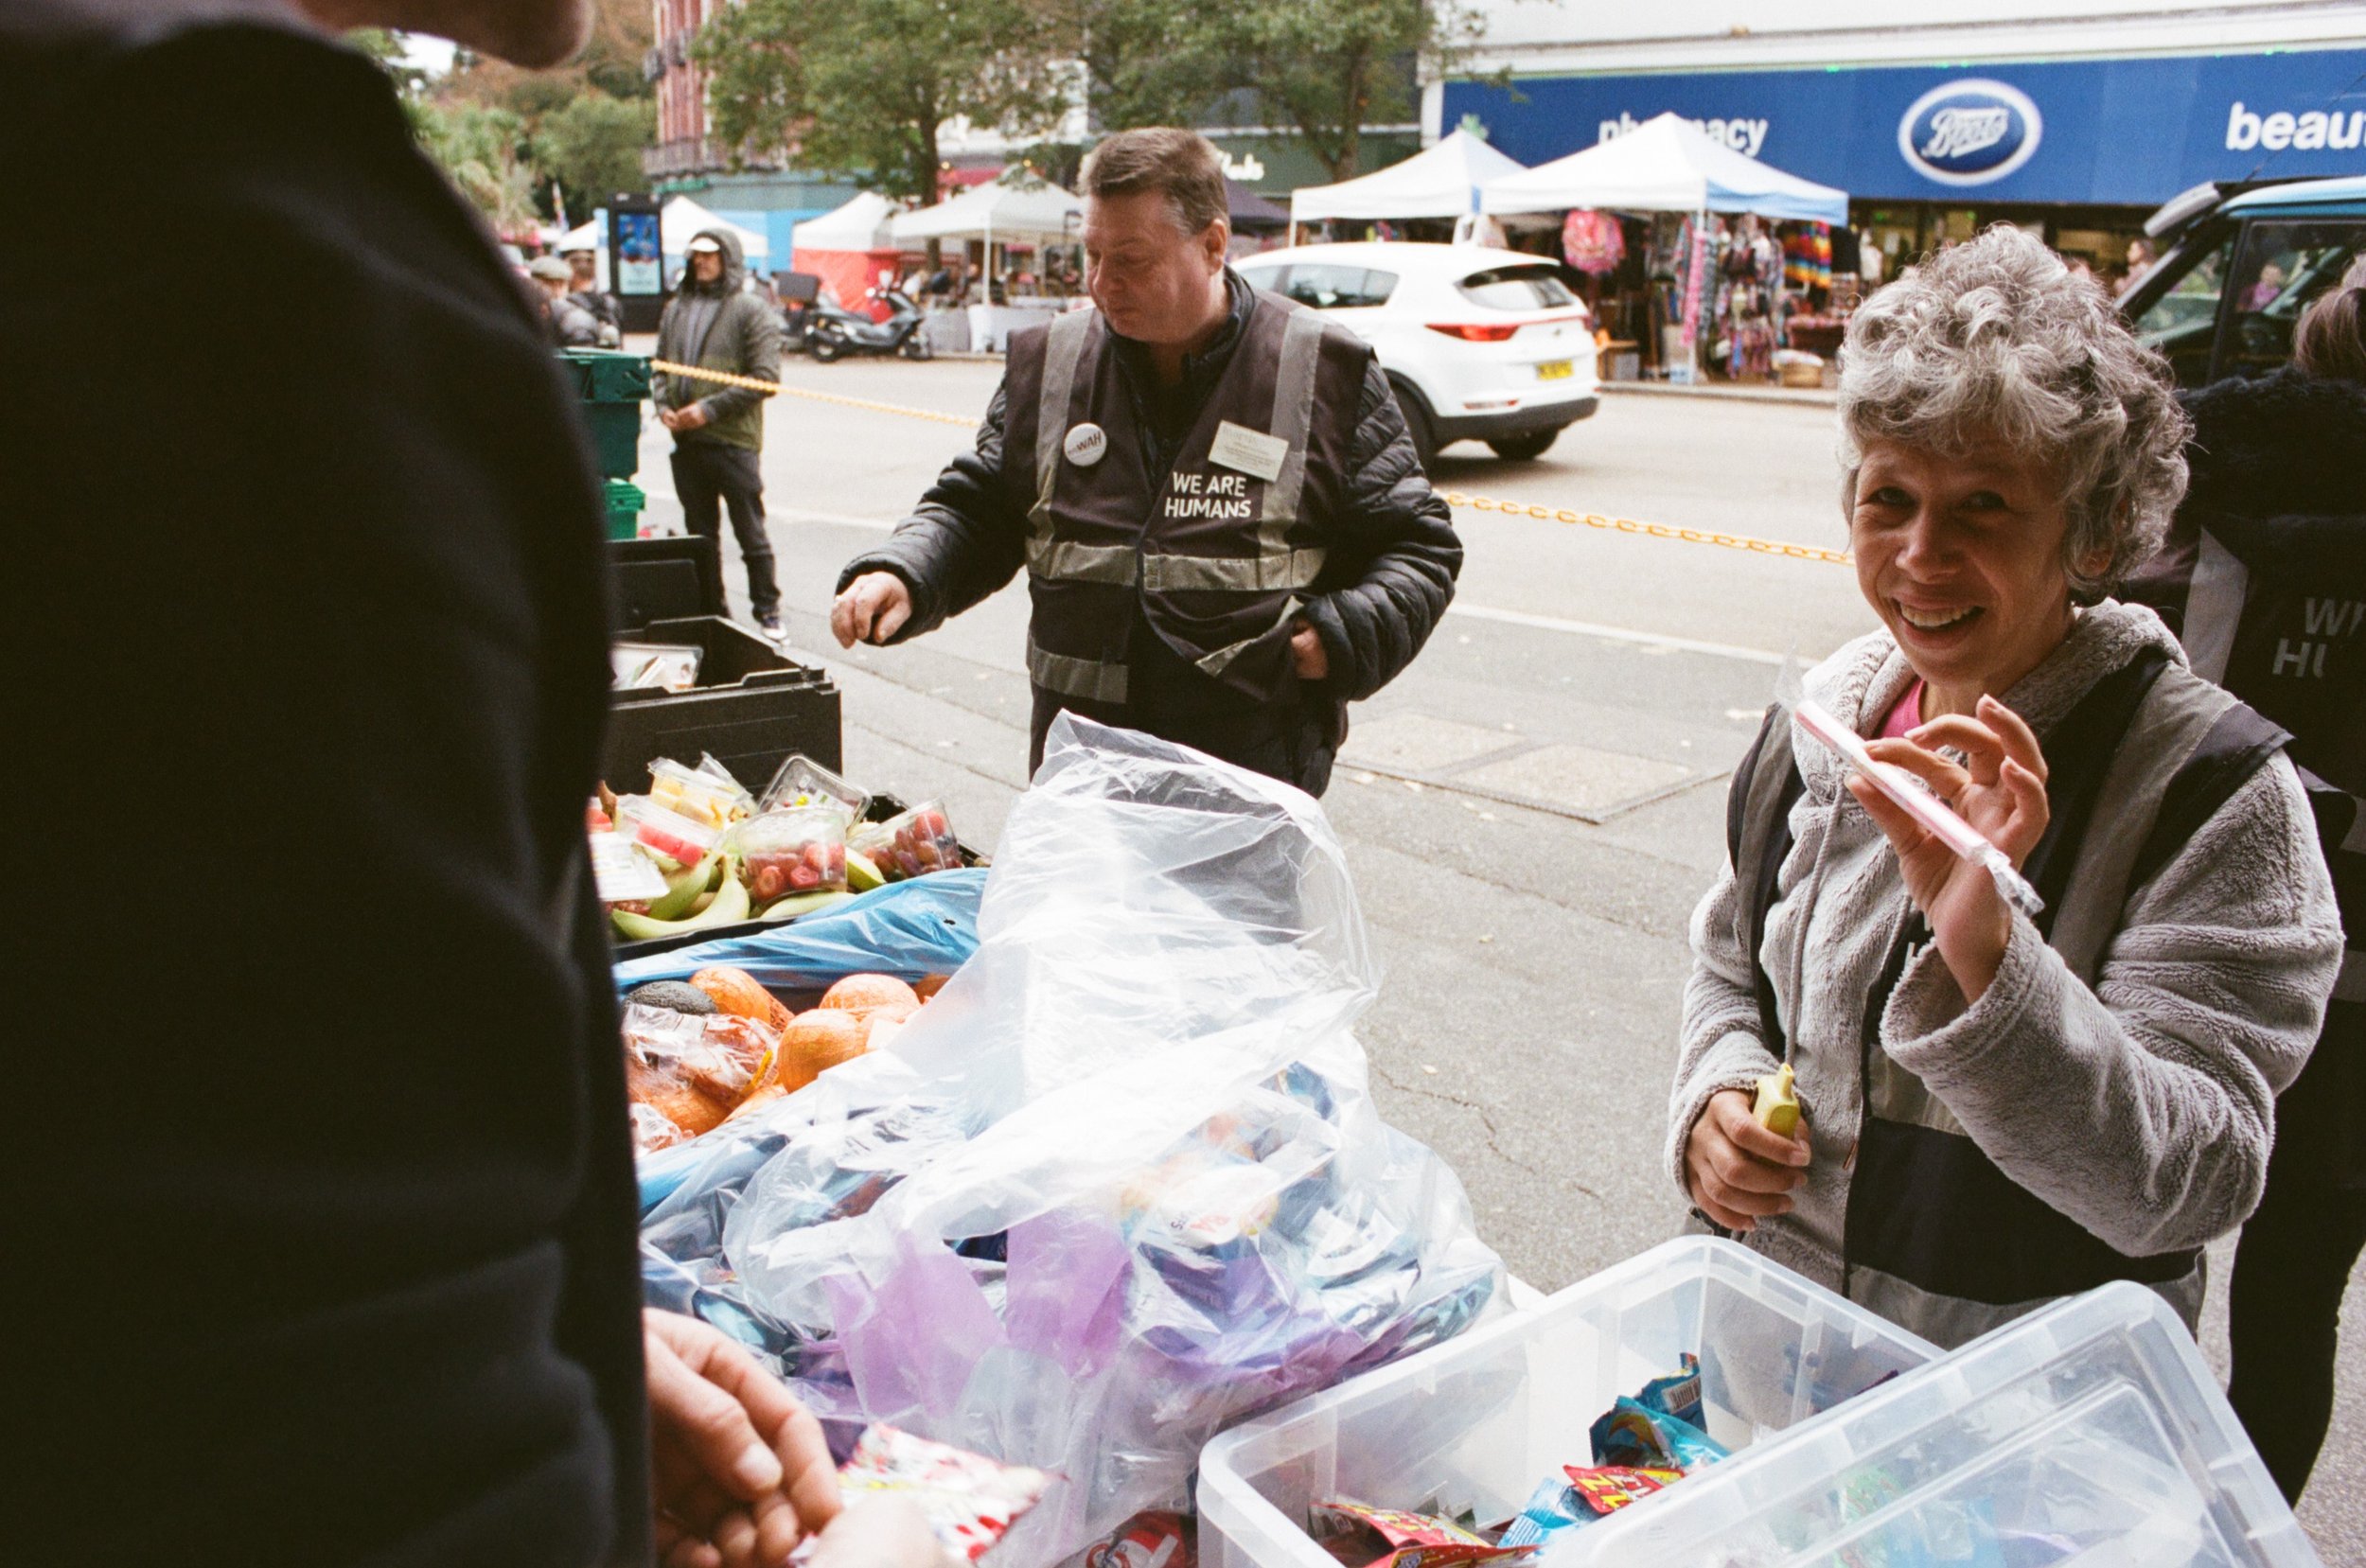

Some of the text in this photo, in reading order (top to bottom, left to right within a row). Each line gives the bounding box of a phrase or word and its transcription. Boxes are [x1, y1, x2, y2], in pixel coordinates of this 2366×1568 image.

[2225, 100, 2366, 150] beau
[1173, 471, 1246, 498] WE ARE
[1164, 497, 1251, 519] HUMANS
